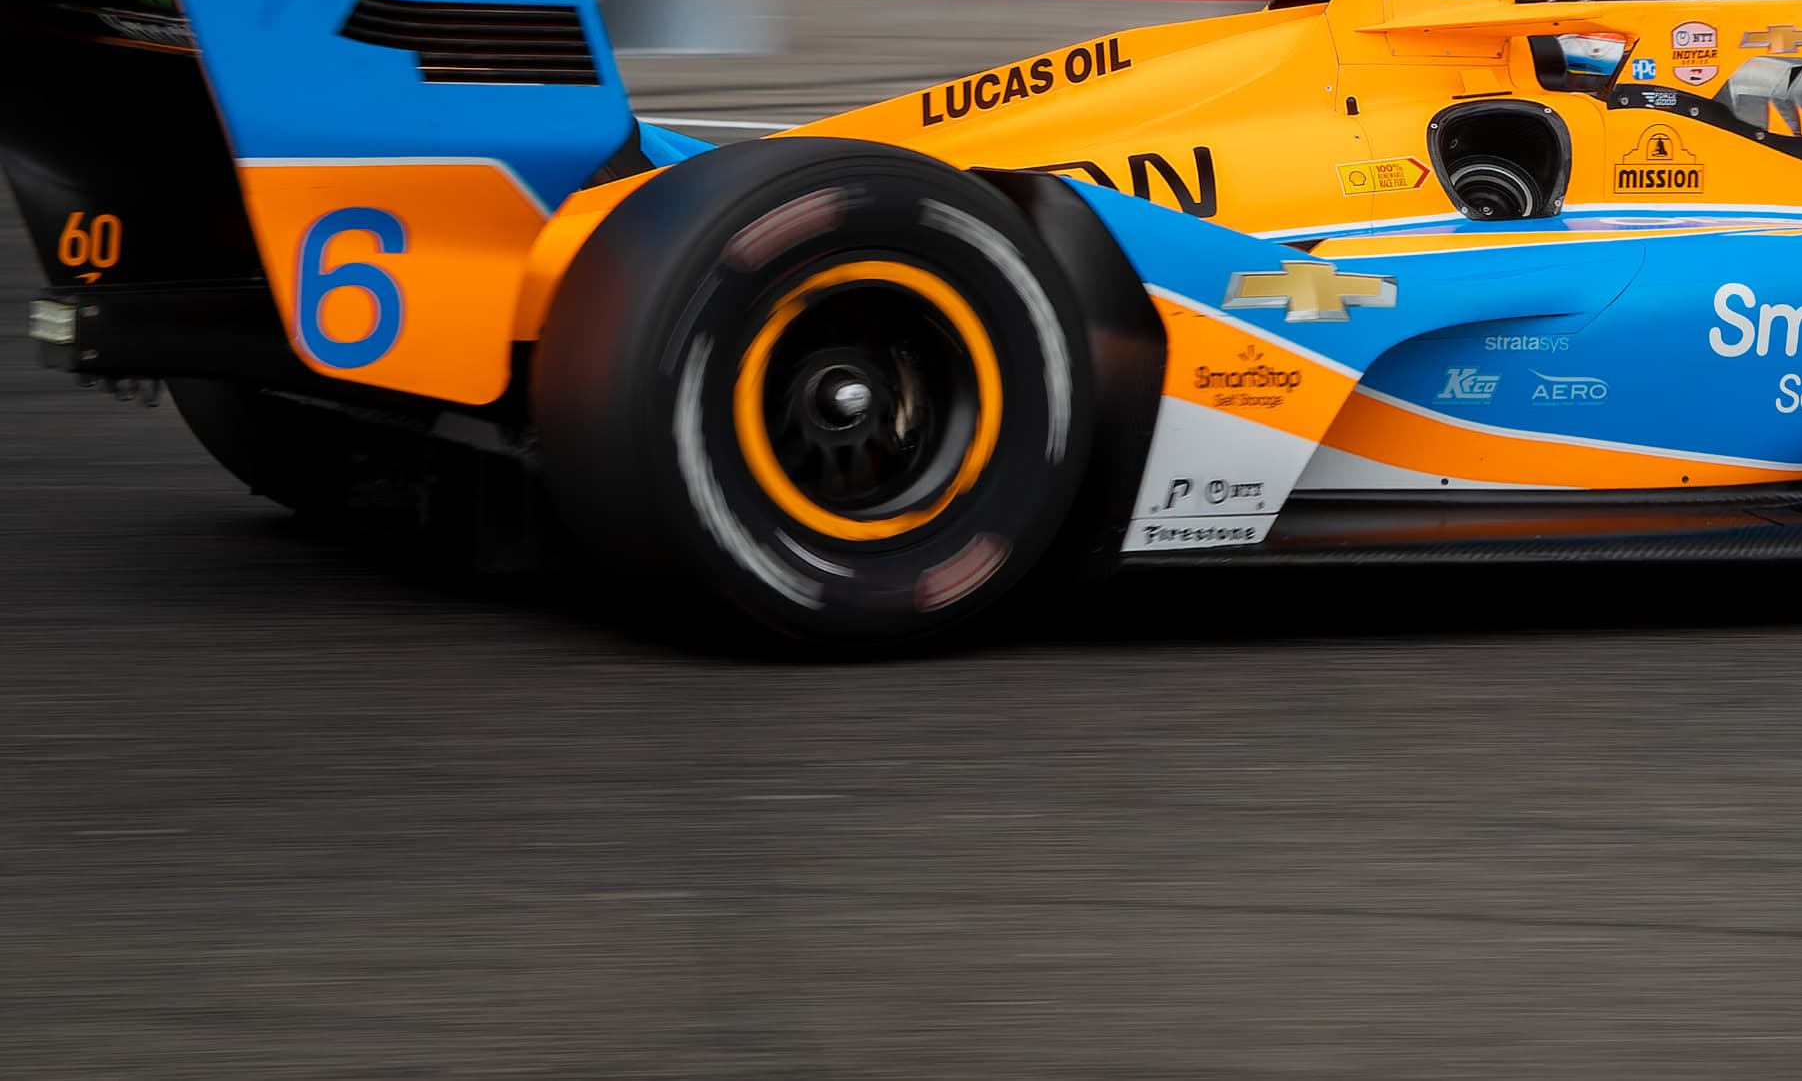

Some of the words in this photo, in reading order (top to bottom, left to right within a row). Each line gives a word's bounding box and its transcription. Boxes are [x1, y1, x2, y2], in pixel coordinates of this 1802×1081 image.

[1672, 49, 1718, 60] INDYCAR
[922, 57, 1054, 127] LUCAS
[1065, 37, 1132, 84] OIL
[1618, 169, 1699, 188] MISSION
[58, 211, 122, 268] 60
[296, 206, 407, 369] 6
[1485, 335, 1569, 353] stratasys
[1194, 365, 1301, 392] SmartStop
[1531, 384, 1608, 400] AERO
[1143, 525, 1257, 545] Firestone
